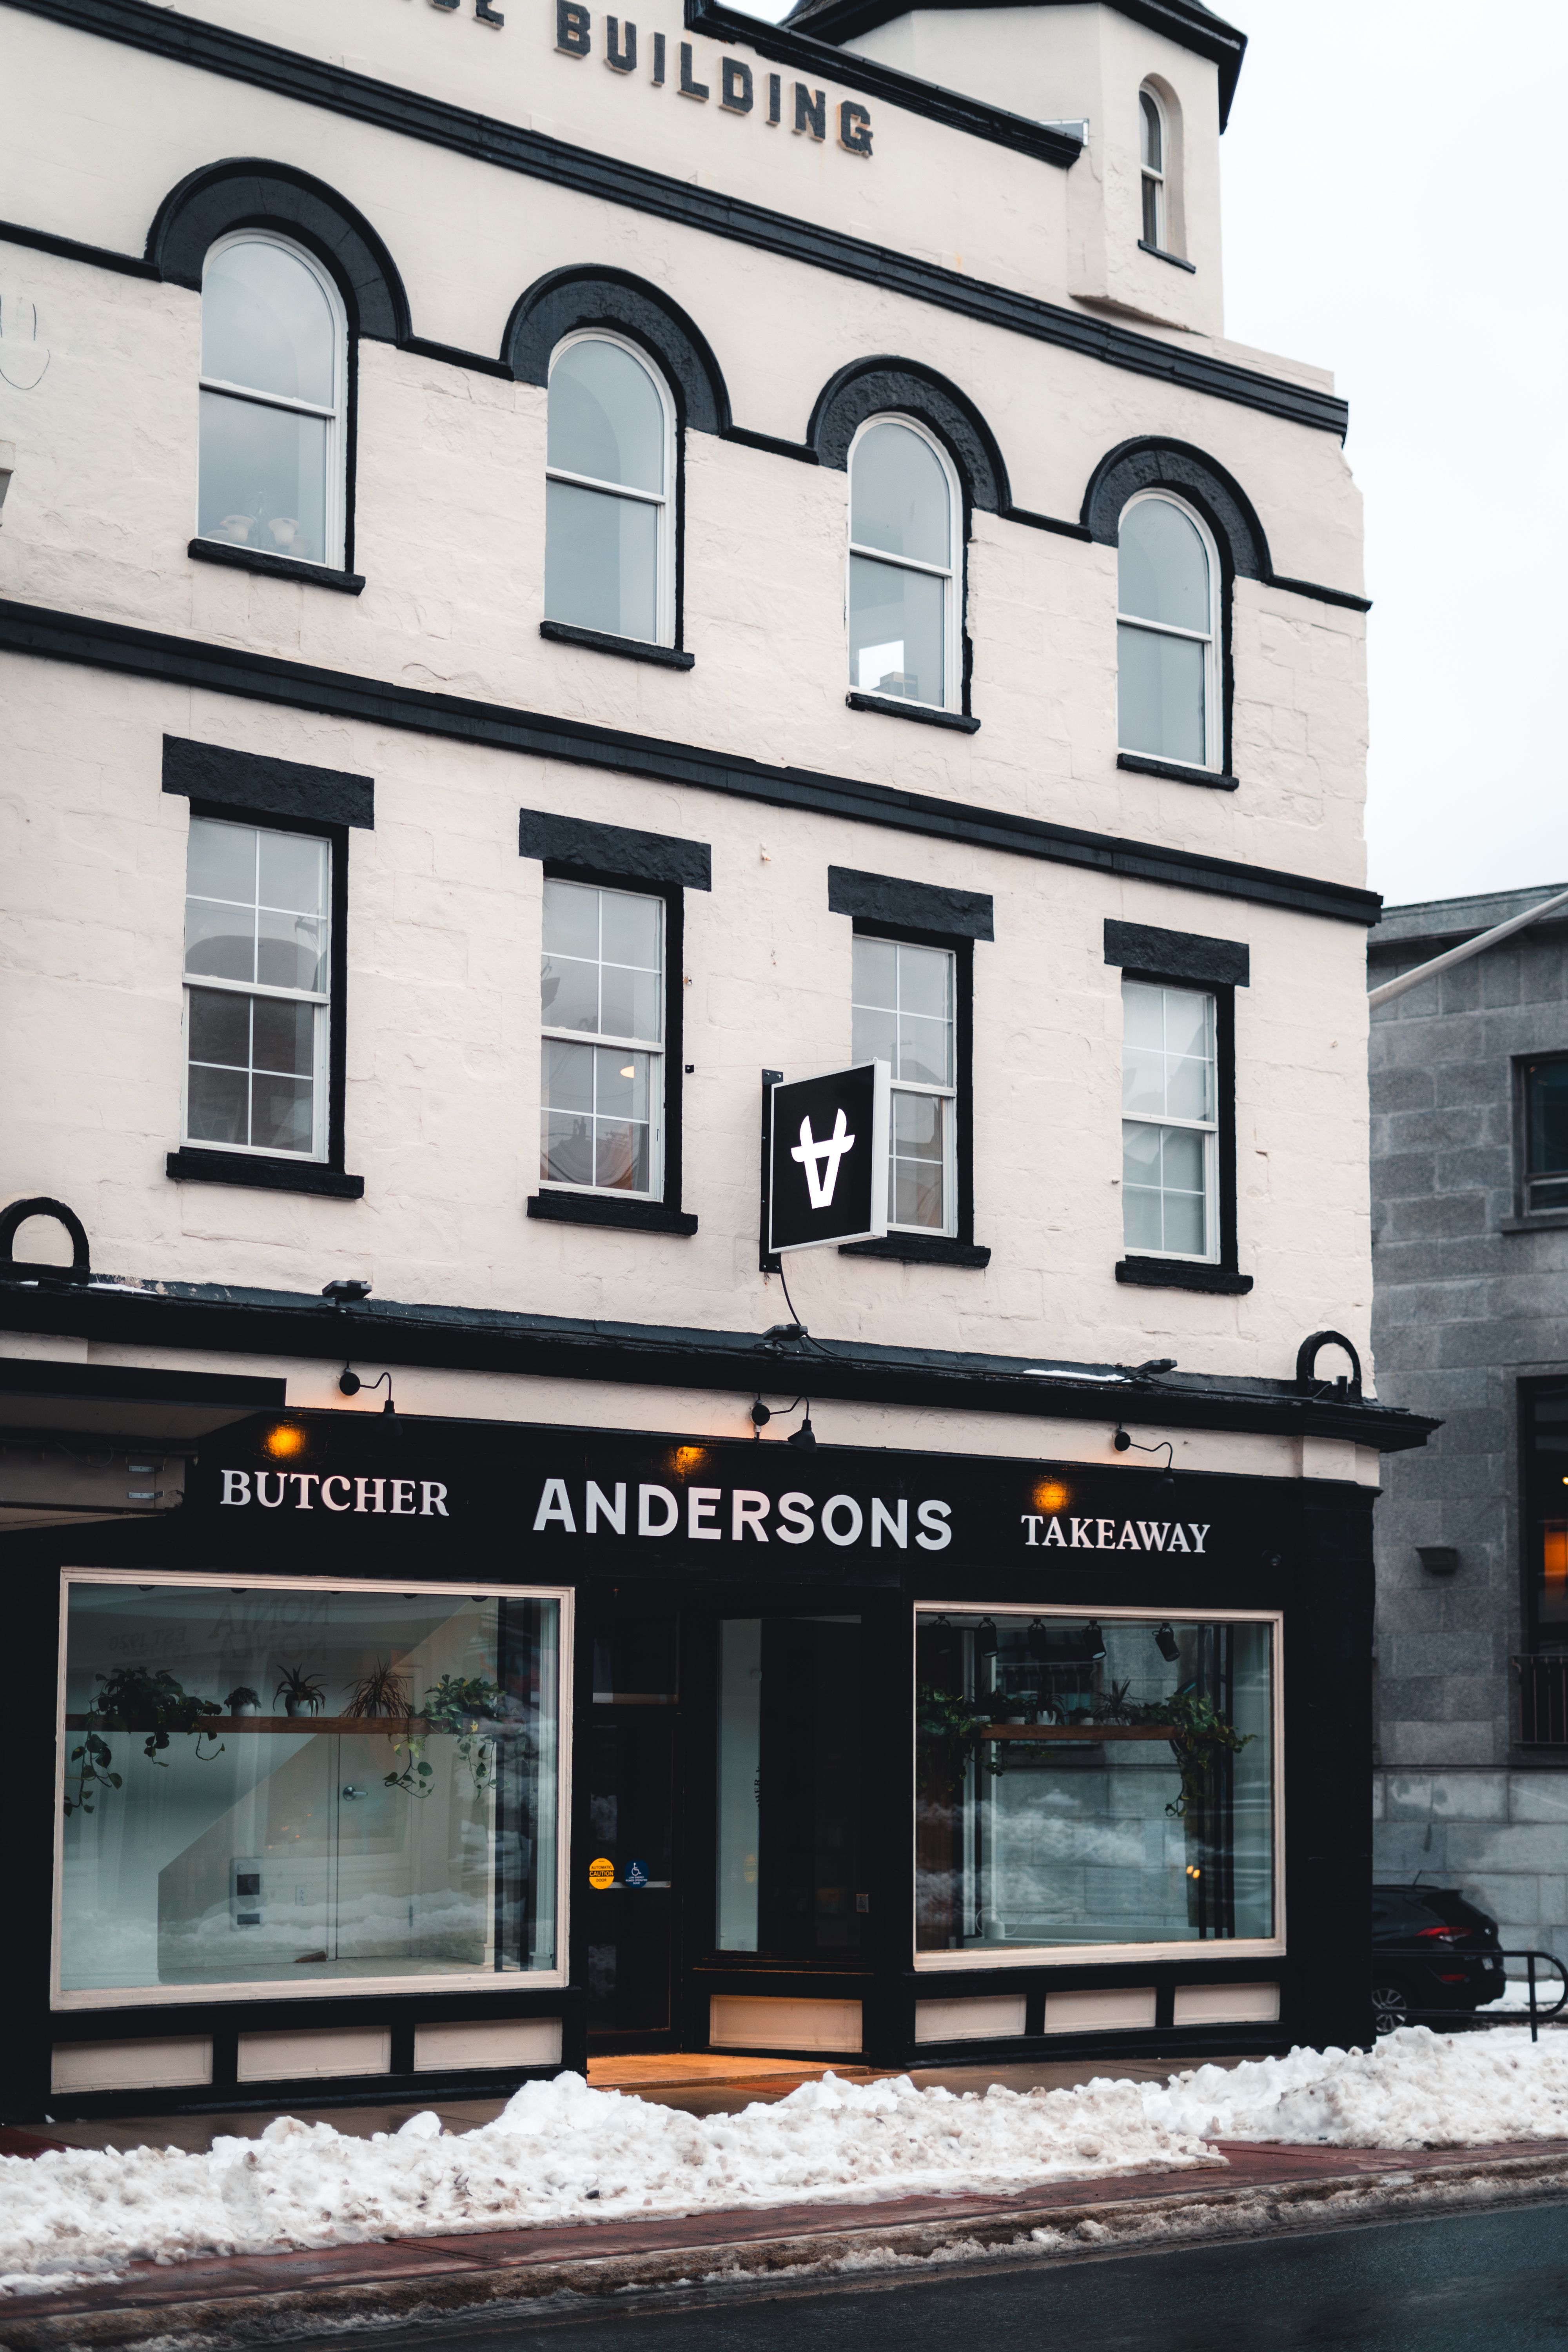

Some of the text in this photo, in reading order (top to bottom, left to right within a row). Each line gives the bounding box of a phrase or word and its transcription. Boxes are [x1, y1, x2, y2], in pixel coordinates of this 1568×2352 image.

[554, 0, 874, 158] BUILDING
[220, 1470, 450, 1516] BUTCHER
[533, 1478, 952, 1551] ANDERSONS
[1021, 1515, 1210, 1553] TAKEAWAY
